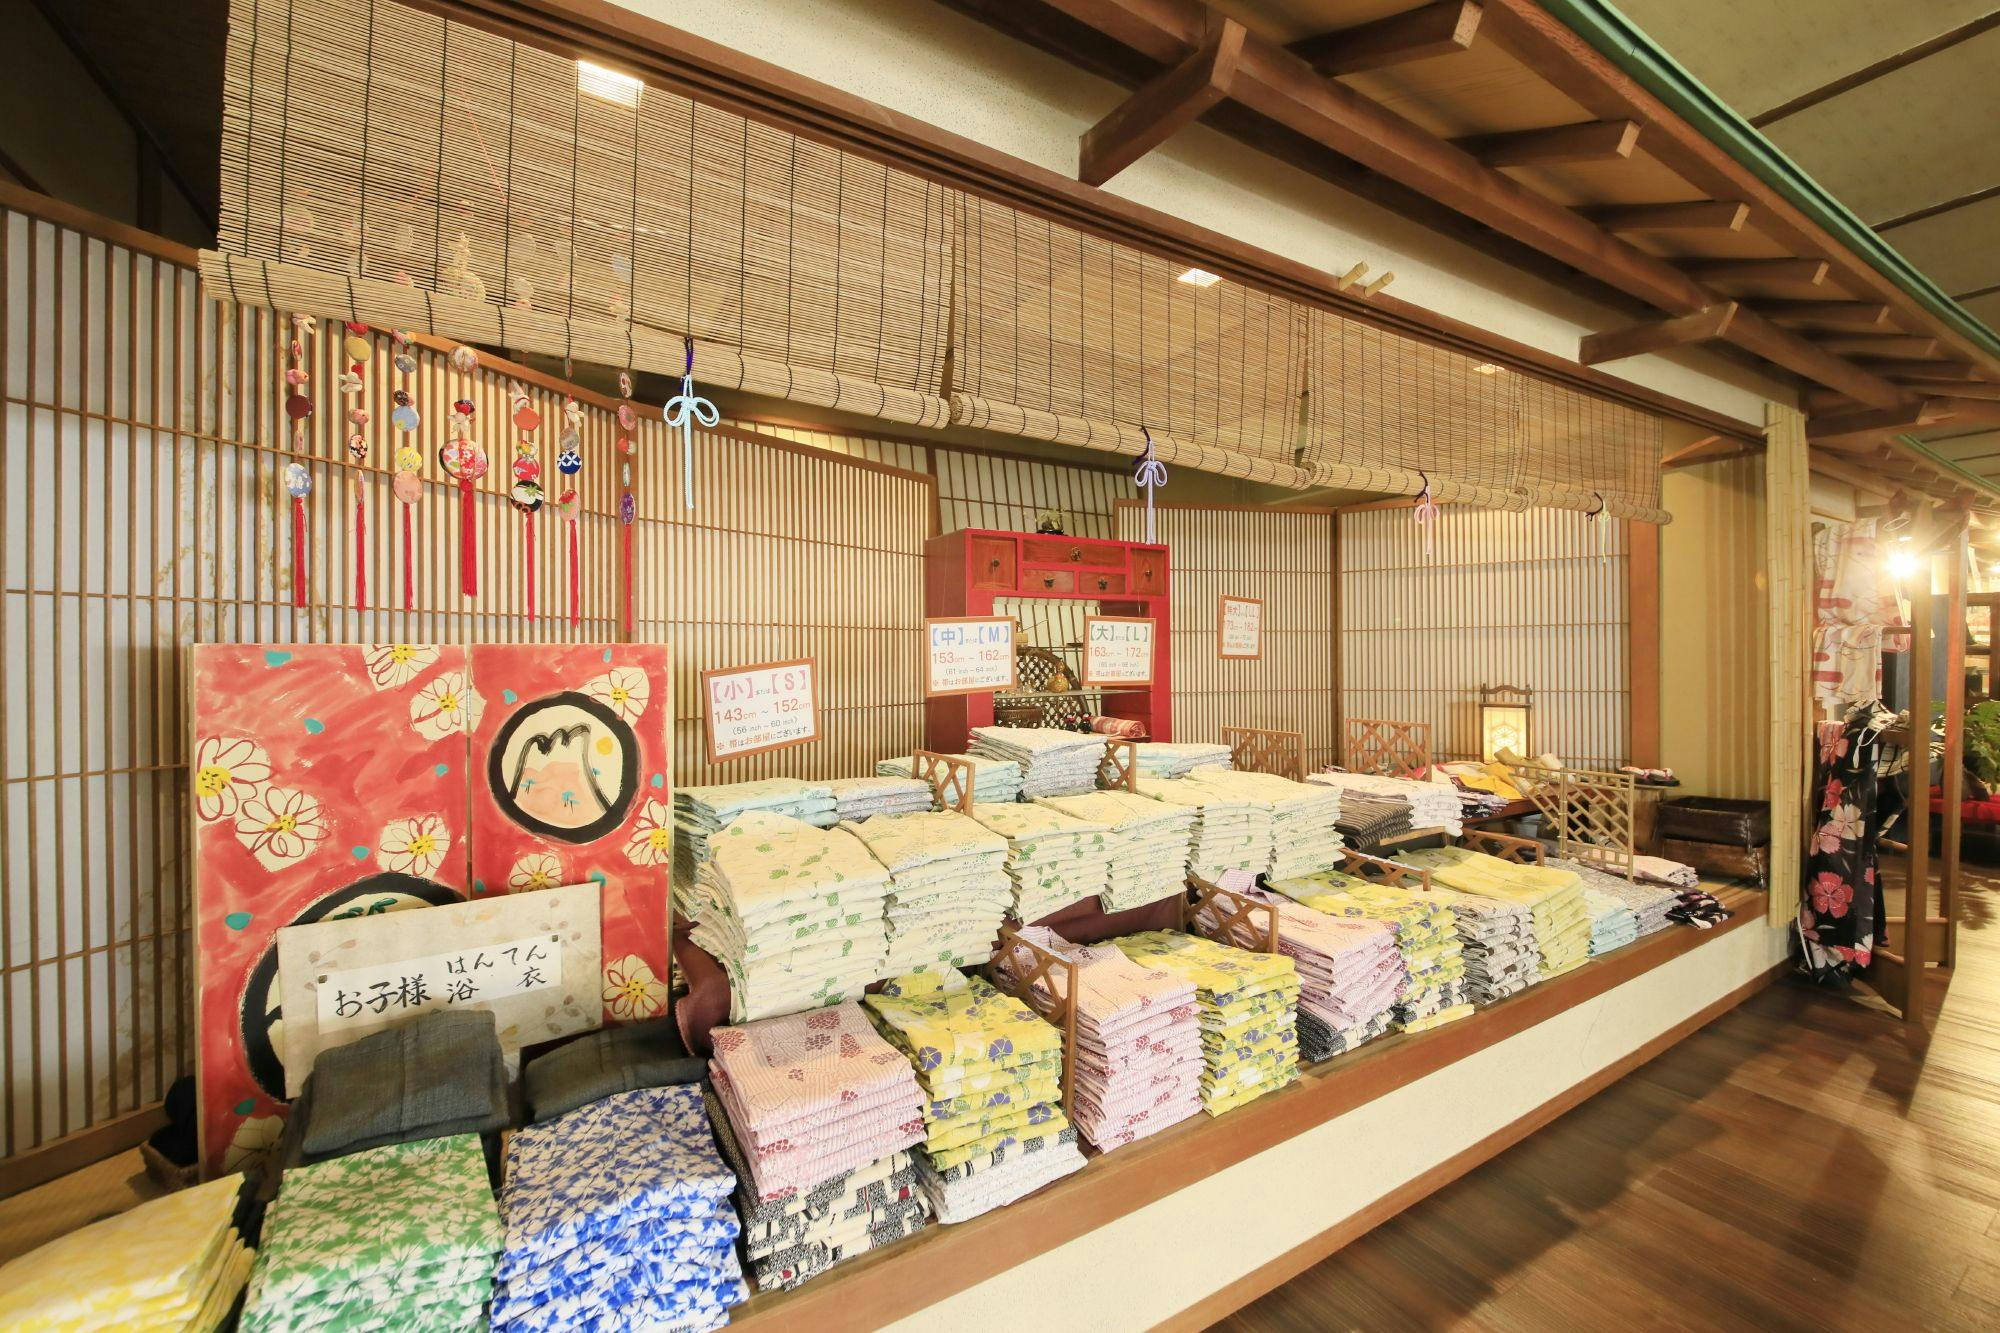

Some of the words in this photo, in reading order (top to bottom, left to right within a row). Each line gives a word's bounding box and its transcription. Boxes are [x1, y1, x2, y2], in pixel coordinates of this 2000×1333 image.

[715, 707, 757, 724] 143cm
[773, 698, 811, 714] 152cm
[447, 945, 547, 974] はんてん
[335, 974, 432, 1018] お子様
